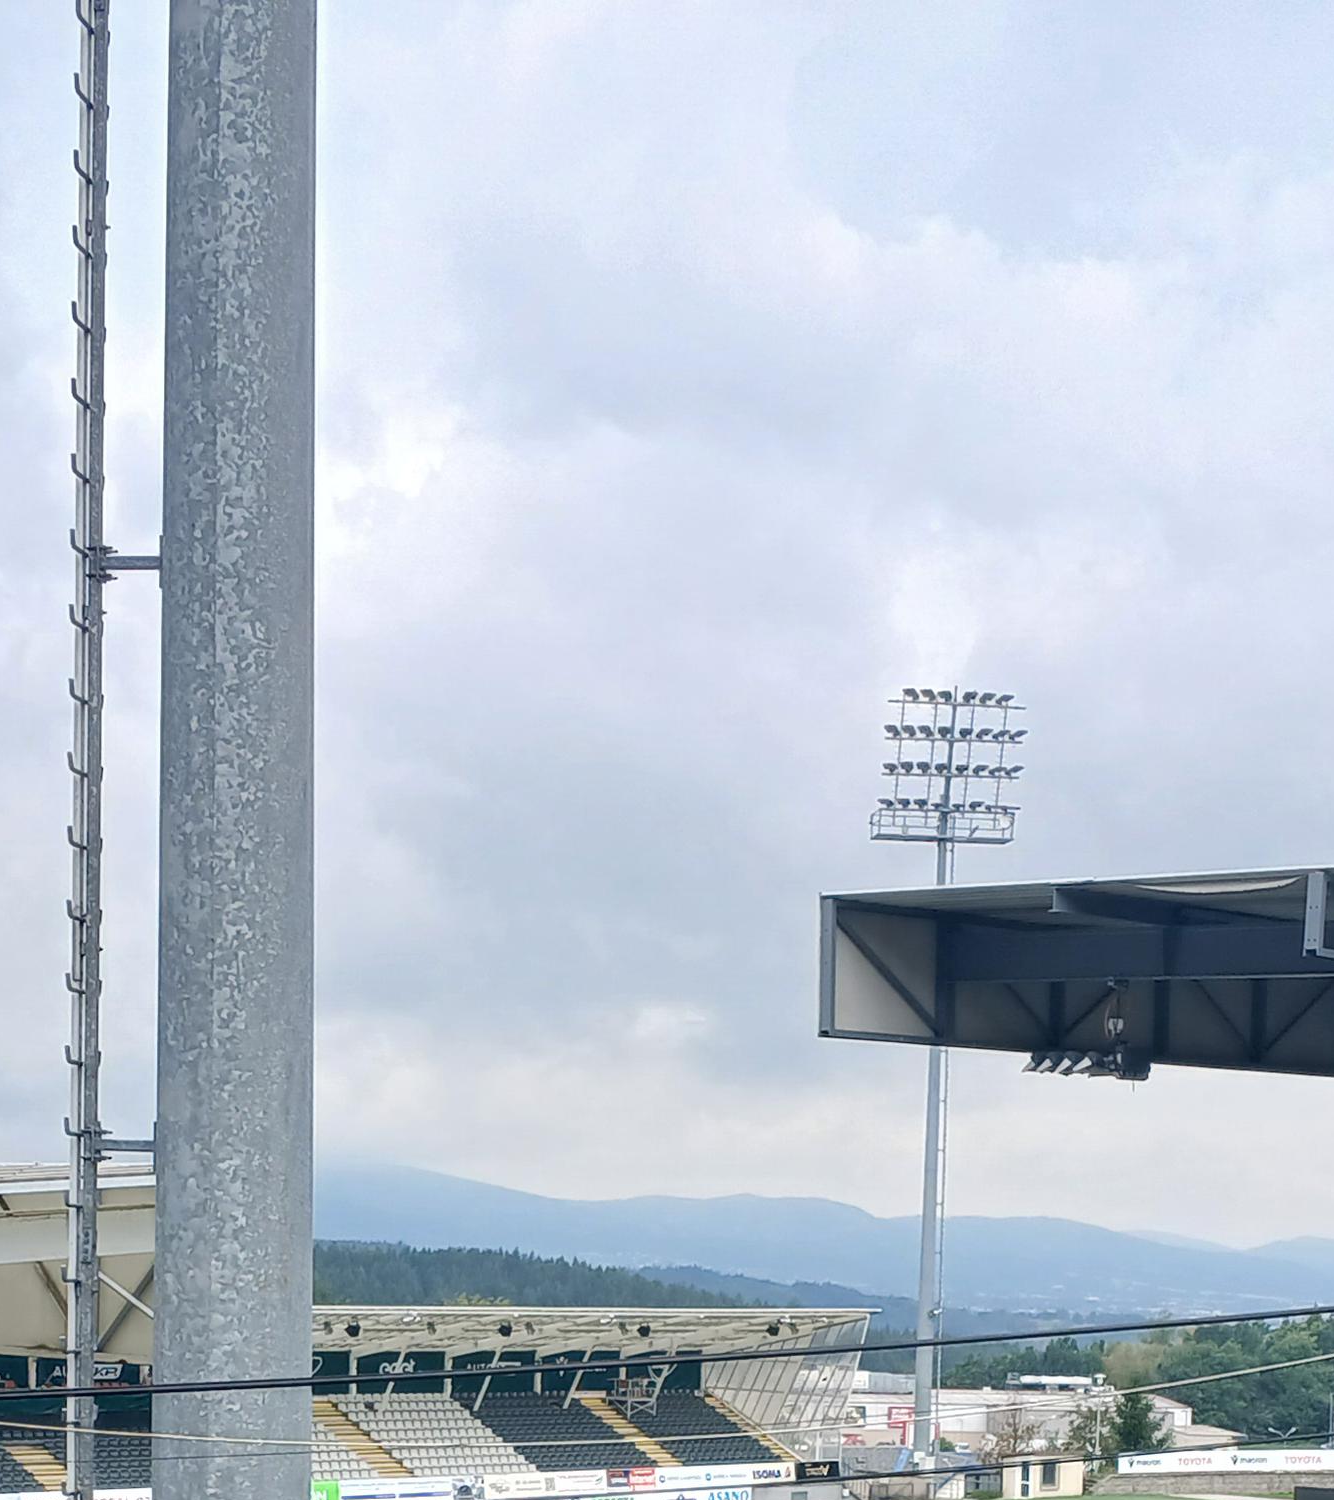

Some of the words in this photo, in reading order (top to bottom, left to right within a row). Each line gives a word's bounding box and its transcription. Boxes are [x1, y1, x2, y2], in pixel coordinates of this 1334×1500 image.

[1136, 1459, 1161, 1467] macron
[1178, 1457, 1212, 1467] TOYOTA
[1239, 1457, 1267, 1465] macron
[1284, 1455, 1322, 1465] TOYOTA
[752, 1469, 782, 1480] ISOMA
